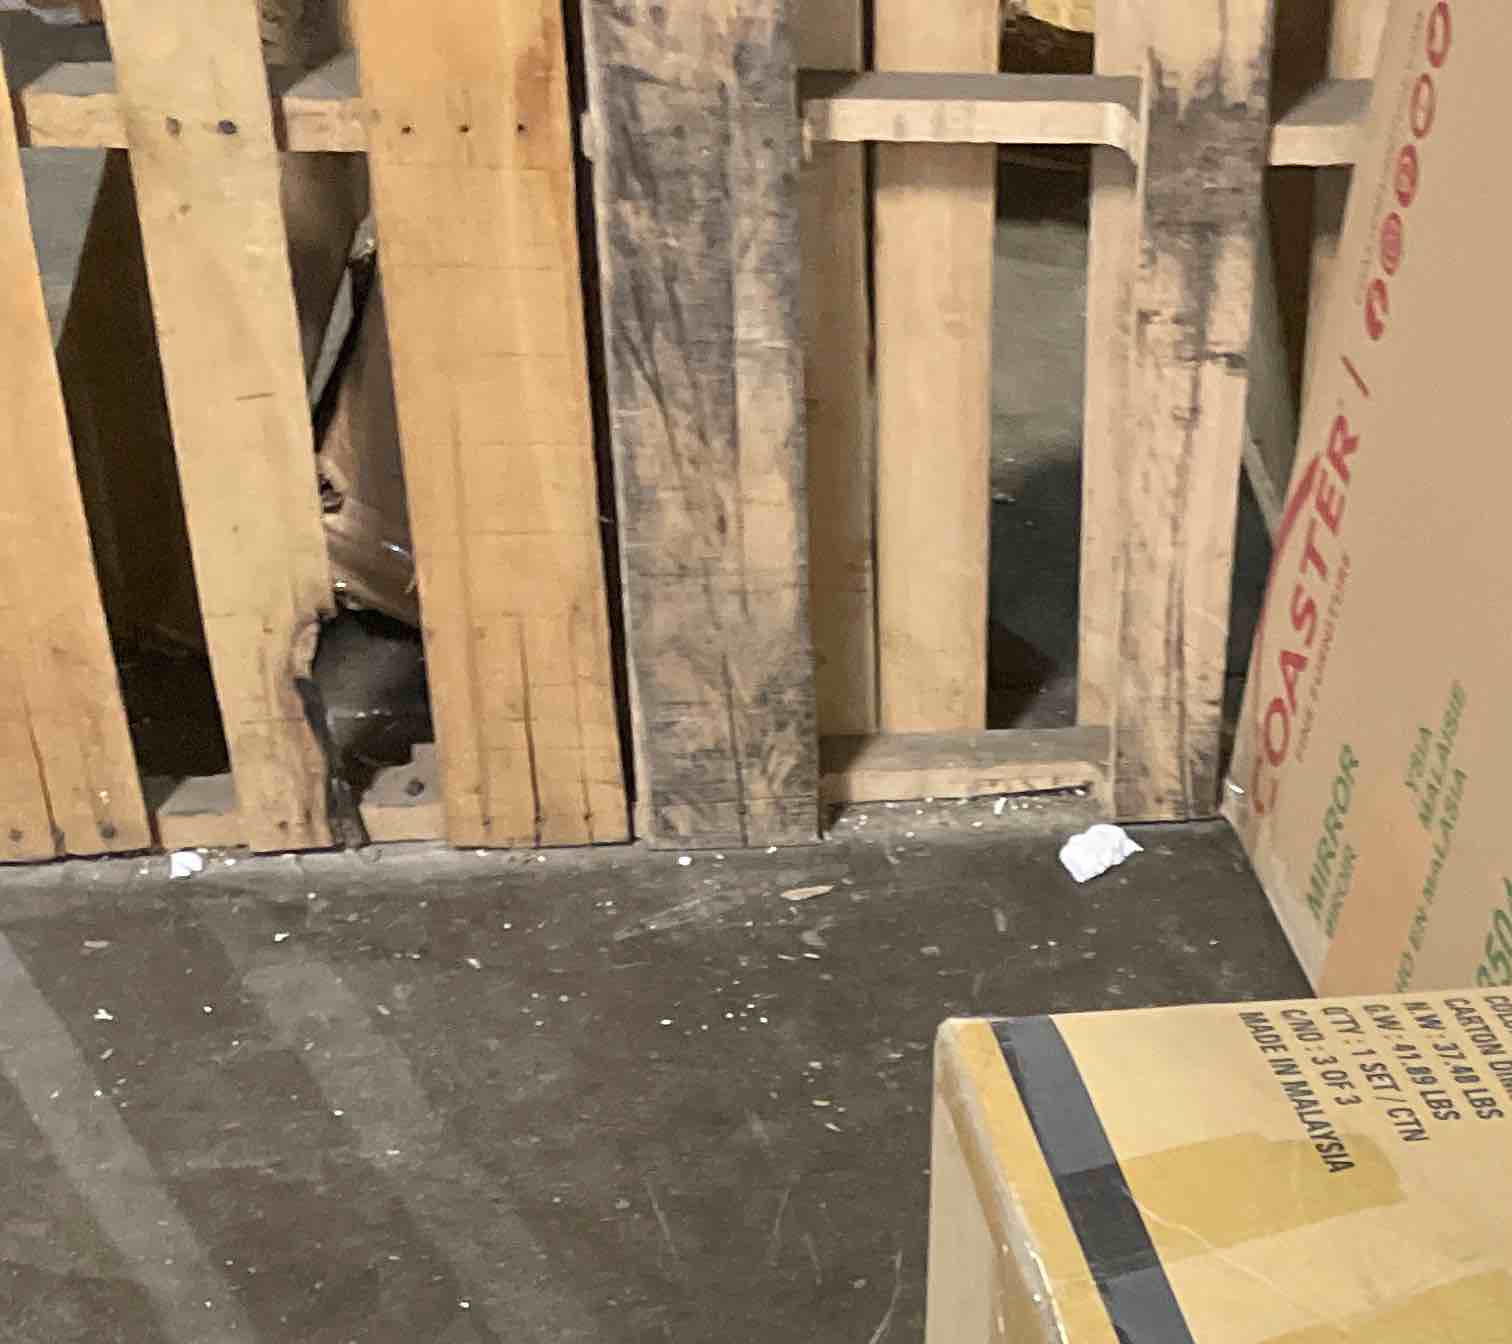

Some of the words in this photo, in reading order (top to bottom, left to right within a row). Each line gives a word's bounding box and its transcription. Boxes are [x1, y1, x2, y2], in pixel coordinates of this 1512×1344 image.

[1252, 415, 1360, 815] COASTER
[1307, 744, 1359, 919] MIRROR
[1236, 1007, 1287, 1055] MADE
[1441, 993, 1507, 1057] CARTON
[1265, 1054, 1302, 1079] IN
[1317, 1066, 1355, 1093] OF
[1277, 1077, 1357, 1173] MALAYSIA
[1355, 1058, 1400, 1094] SET
[1384, 1104, 1429, 1143] CTN
[1417, 1086, 1461, 1123] LBS
[1460, 1084, 1506, 1121] LBS
